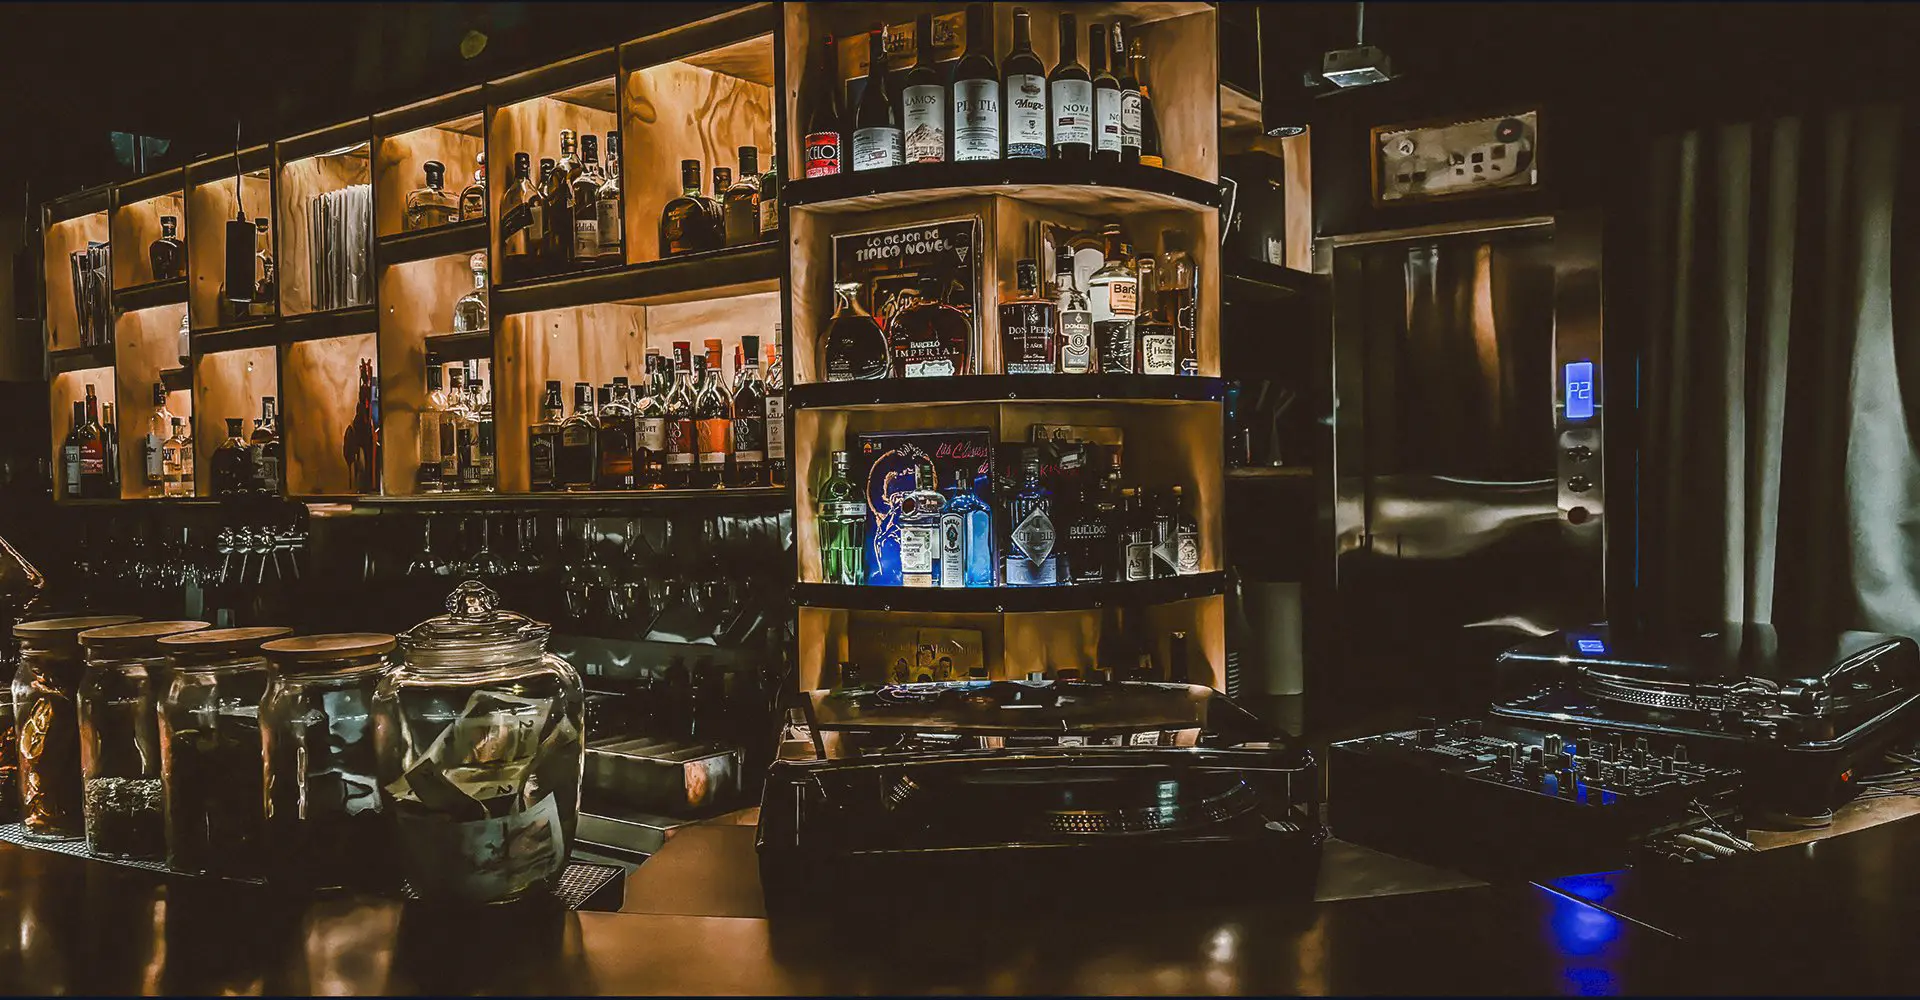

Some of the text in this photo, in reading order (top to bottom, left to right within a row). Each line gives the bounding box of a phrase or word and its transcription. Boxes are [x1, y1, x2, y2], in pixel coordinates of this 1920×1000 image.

[957, 100, 997, 113] PITIA
[867, 229, 938, 247] LO MEJOR DE
[905, 239, 952, 255] NOVEL
[895, 347, 960, 358] IMPERIAL
[1569, 381, 1591, 399] P2
